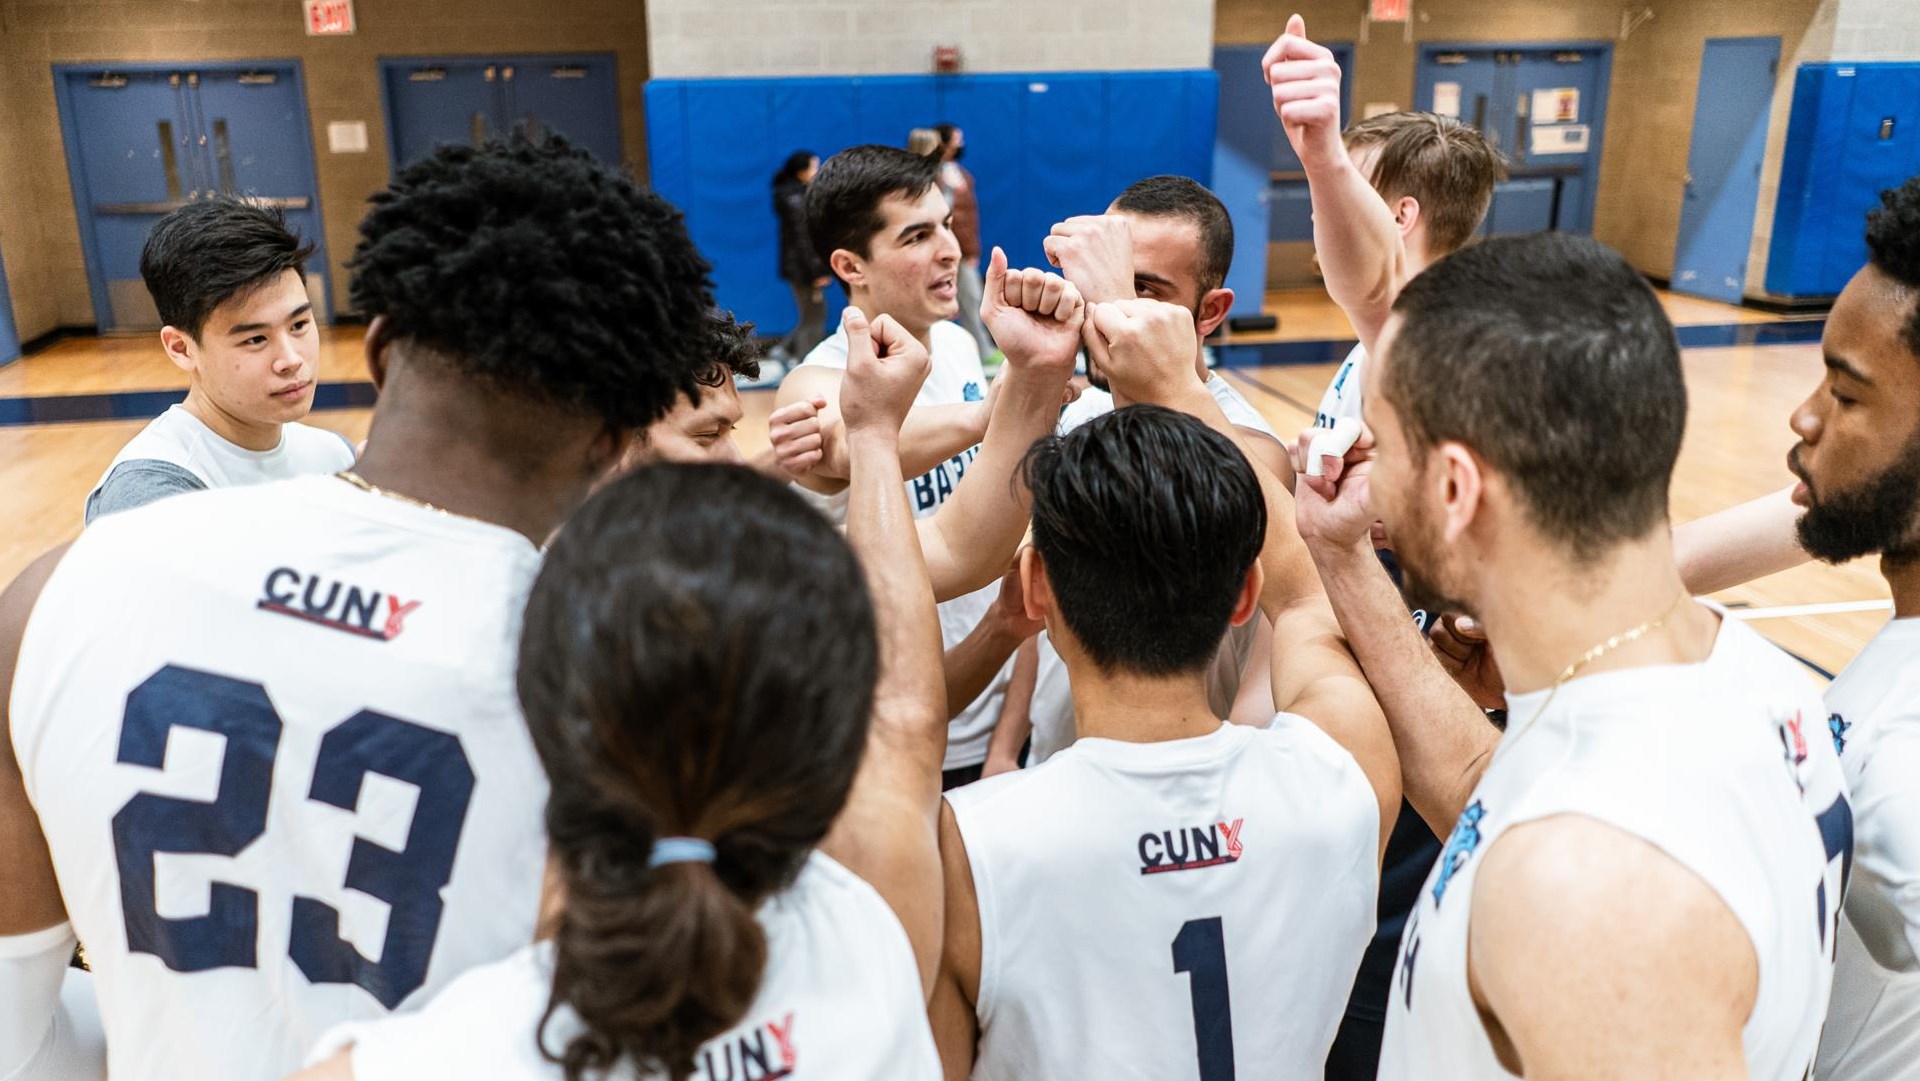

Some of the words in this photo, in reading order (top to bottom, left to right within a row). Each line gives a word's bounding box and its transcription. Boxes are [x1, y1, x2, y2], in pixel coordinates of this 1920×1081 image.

[260, 566, 422, 641] CUNY
[112, 663, 477, 1011] 23
[1138, 818, 1244, 865] CUNY
[1171, 916, 1236, 1081] 1
[704, 1013, 796, 1081] UNY
